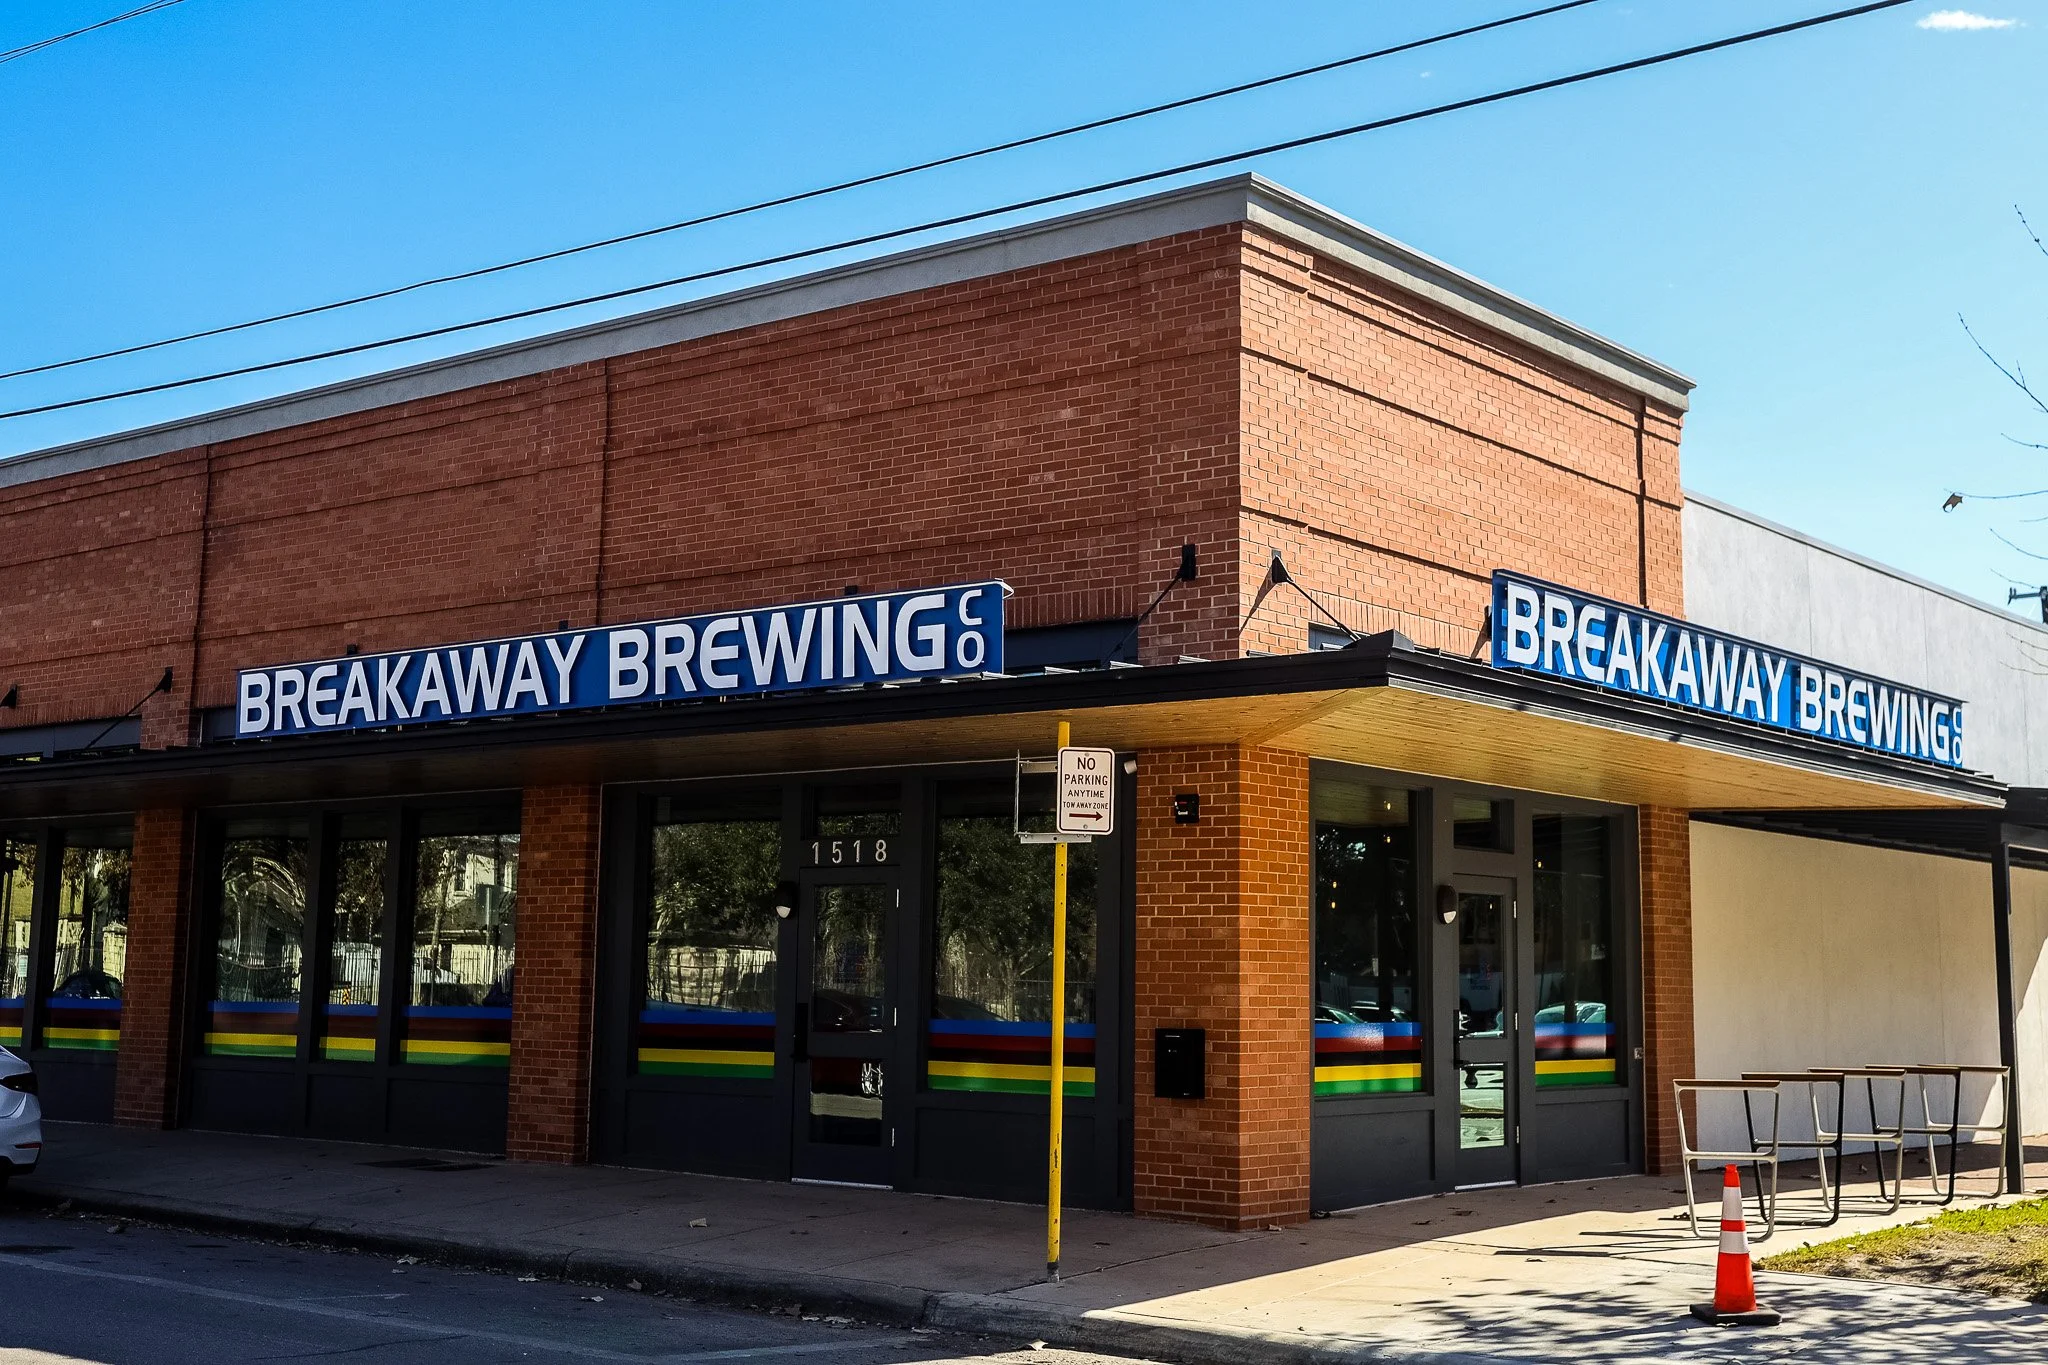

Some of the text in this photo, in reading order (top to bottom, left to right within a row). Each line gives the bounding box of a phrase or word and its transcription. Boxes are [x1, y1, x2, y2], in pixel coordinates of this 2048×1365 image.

[239, 589, 984, 733] BREAKAWAY BREWING CO
[1507, 581, 1963, 765] BREAKAWAY BREWING CO
[1077, 757, 1096, 770] NO
[1064, 774, 1108, 785] PARKING
[1067, 789, 1104, 798] ANYTIME
[812, 839, 887, 864] 1518
